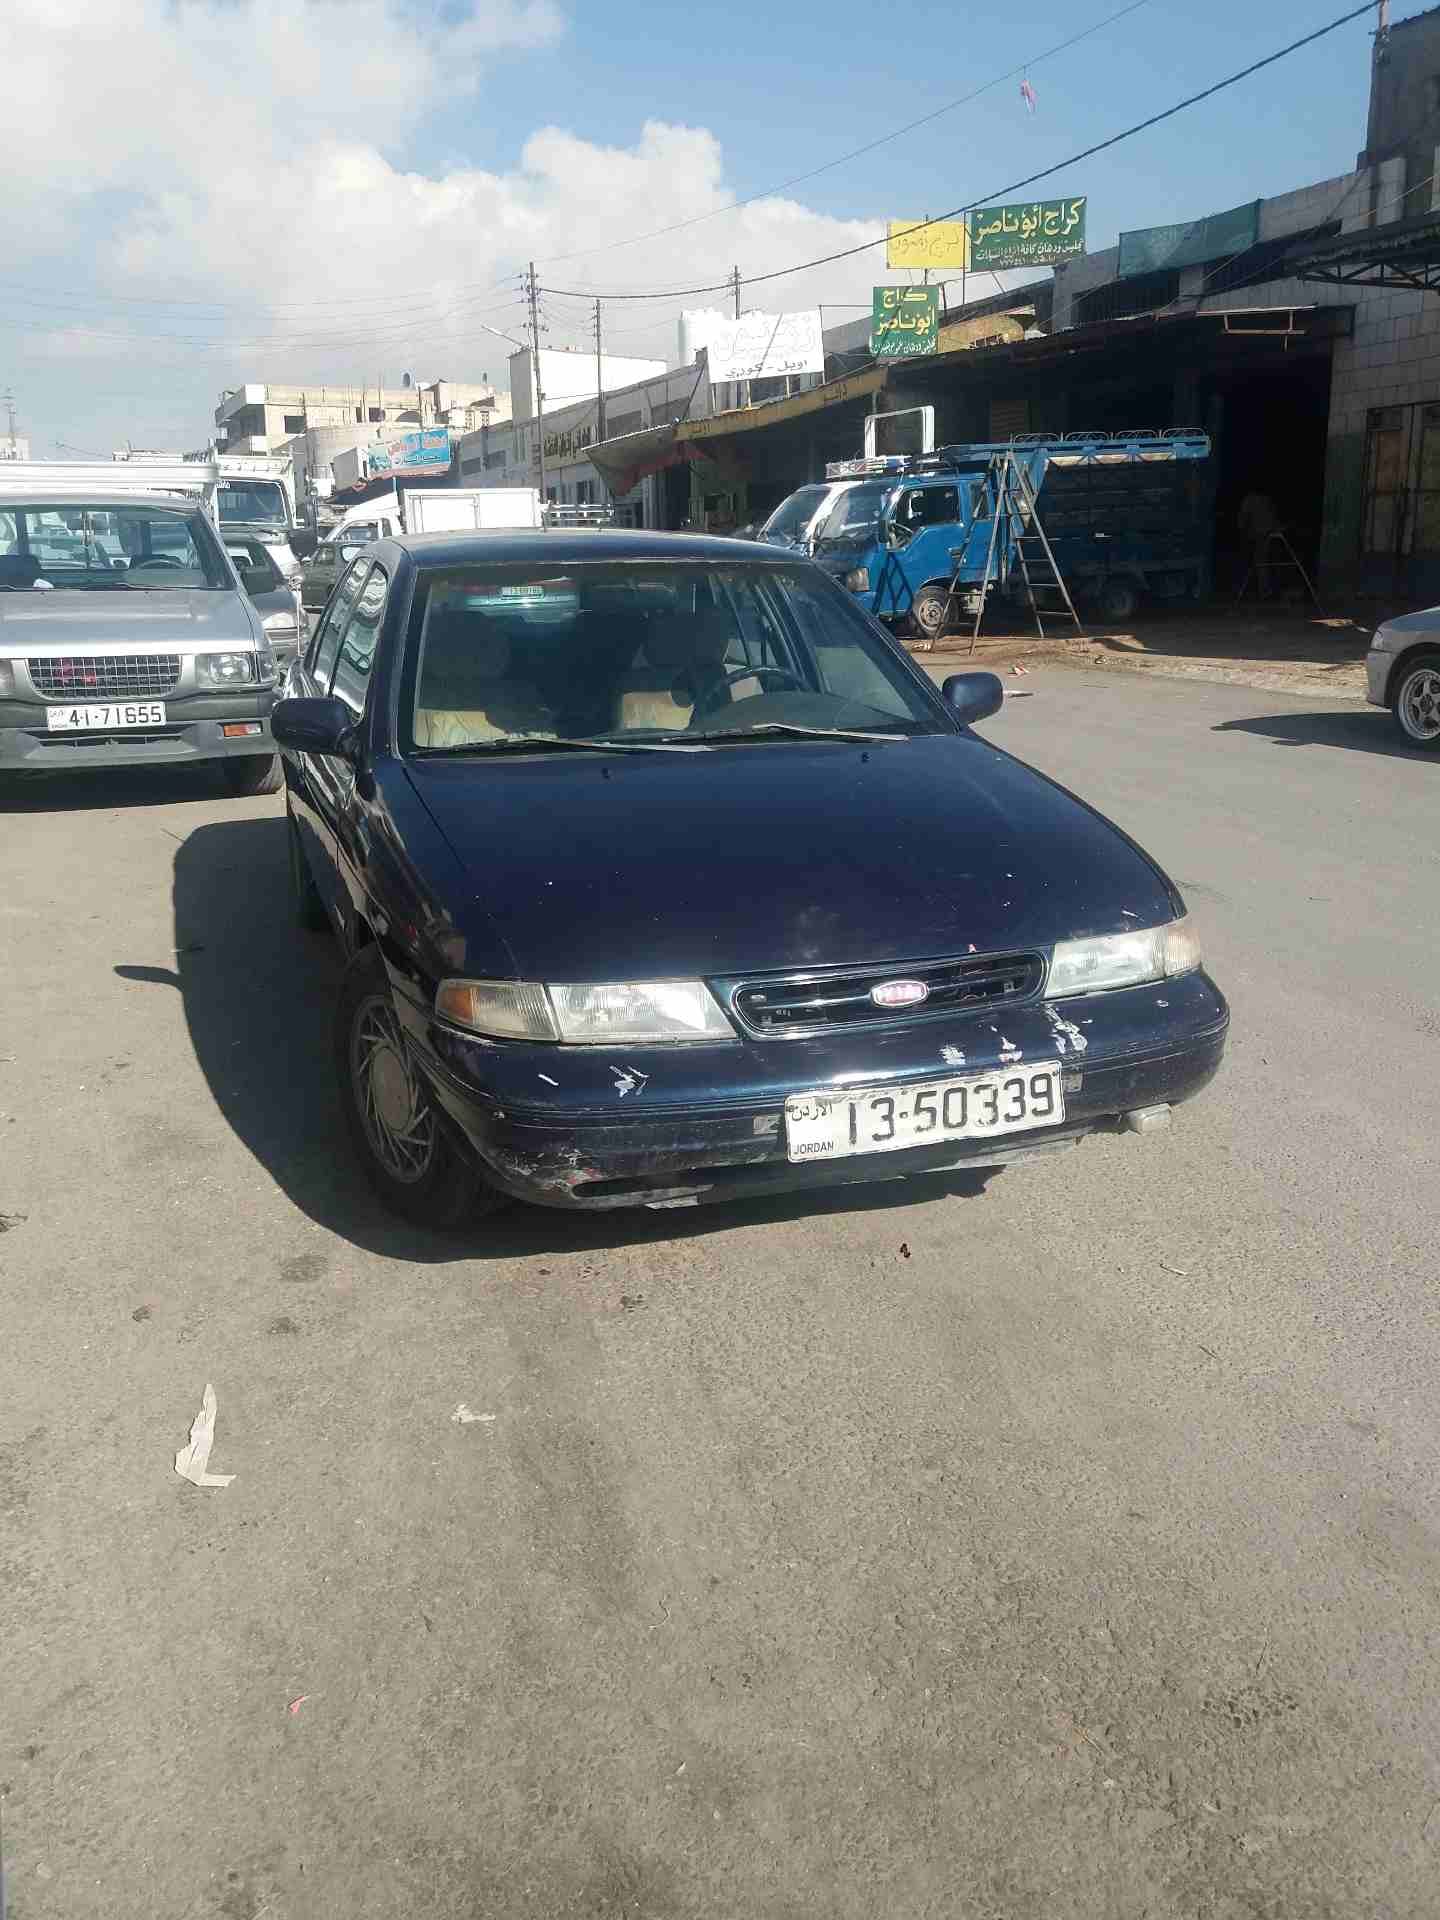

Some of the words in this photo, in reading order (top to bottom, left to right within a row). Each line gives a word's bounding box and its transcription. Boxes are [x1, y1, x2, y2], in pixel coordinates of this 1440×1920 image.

[1044, 197, 1086, 236] كراج
[883, 287, 928, 309] كراج
[848, 1072, 1056, 1147] 13-50339
[792, 1141, 834, 1155] JORDAN
